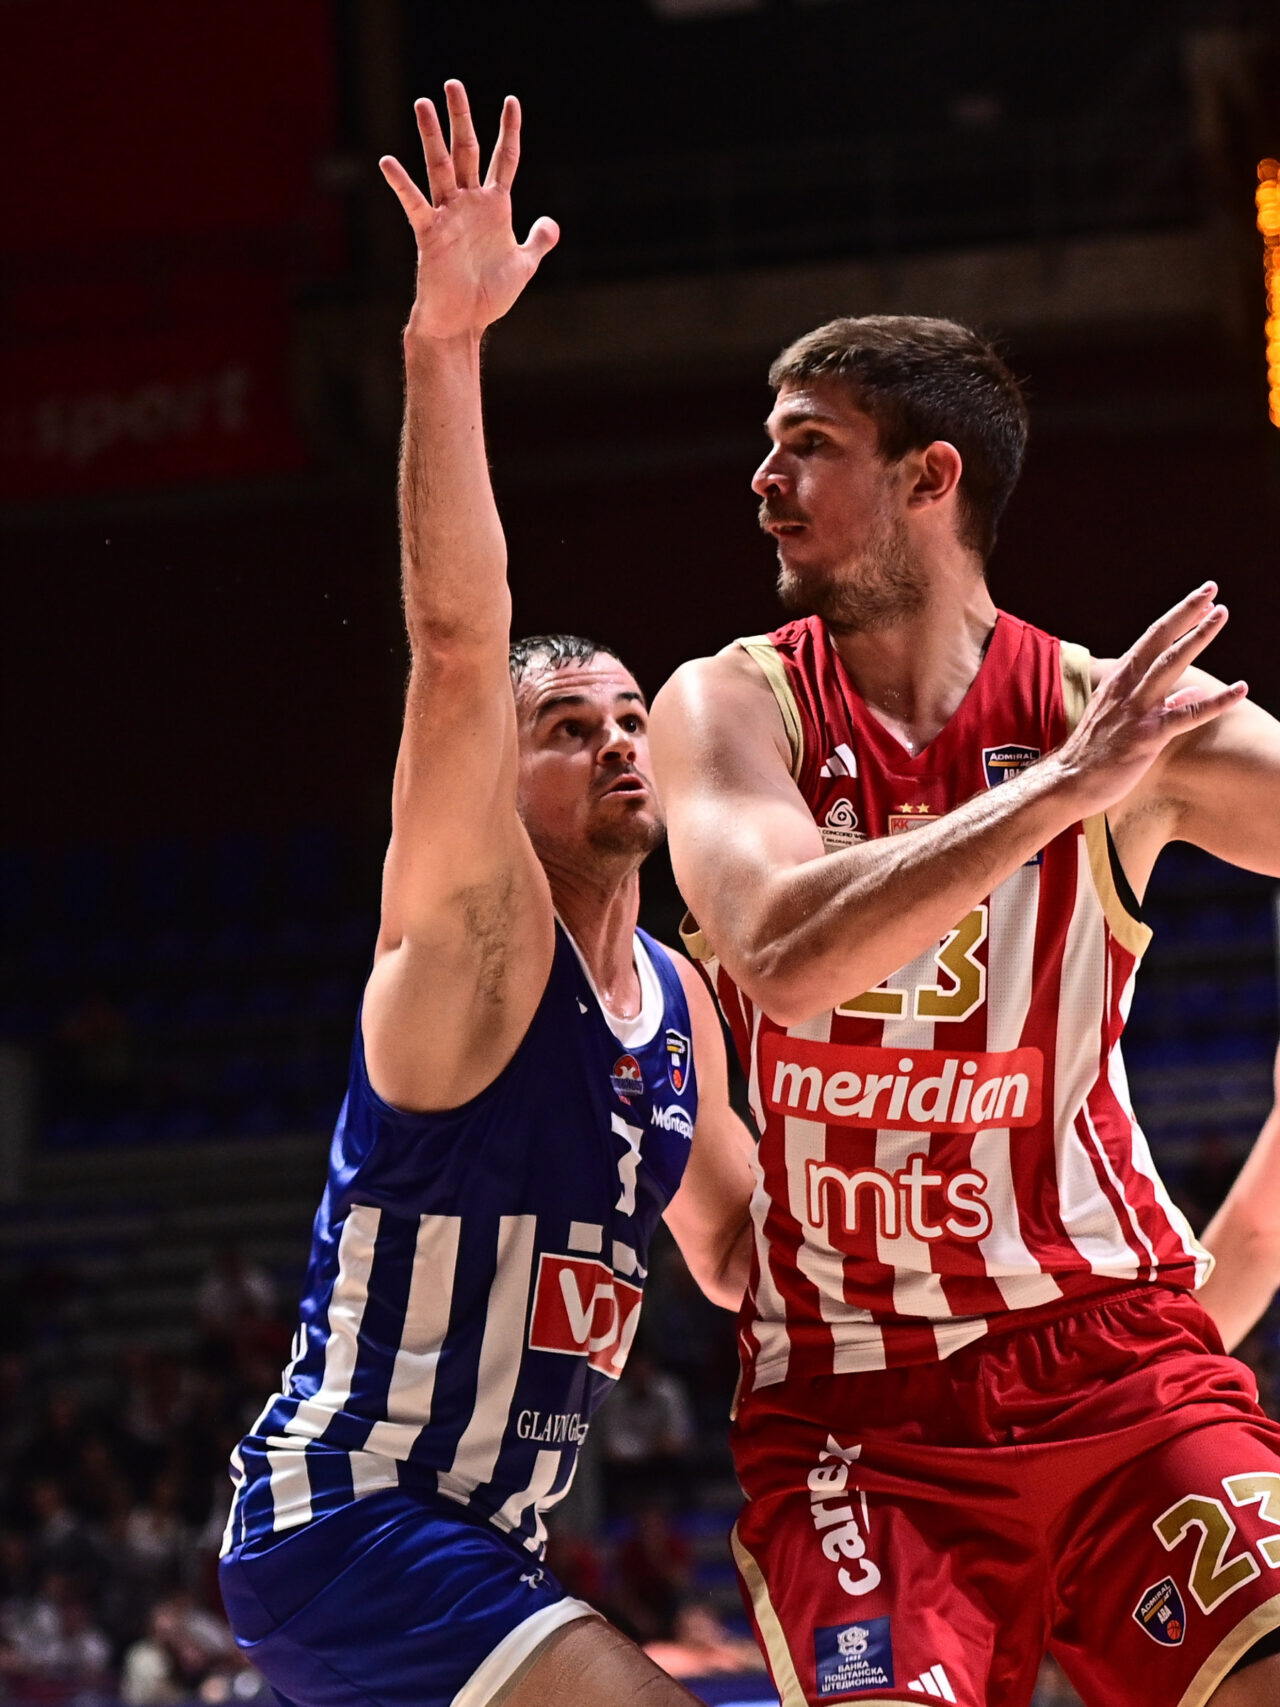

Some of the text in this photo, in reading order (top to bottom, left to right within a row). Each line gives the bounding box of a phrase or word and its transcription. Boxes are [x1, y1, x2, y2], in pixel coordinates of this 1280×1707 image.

[990, 752, 1036, 761] ADMIRAL
[772, 1058, 1029, 1123] meridian
[807, 1156, 992, 1240] mts
[1140, 1583, 1171, 1617] ADMIRAL
[1157, 1604, 1172, 1624] ABA
[824, 1667, 884, 1684] ПОШТАНСКА
[838, 1660, 869, 1673] БАНКА
